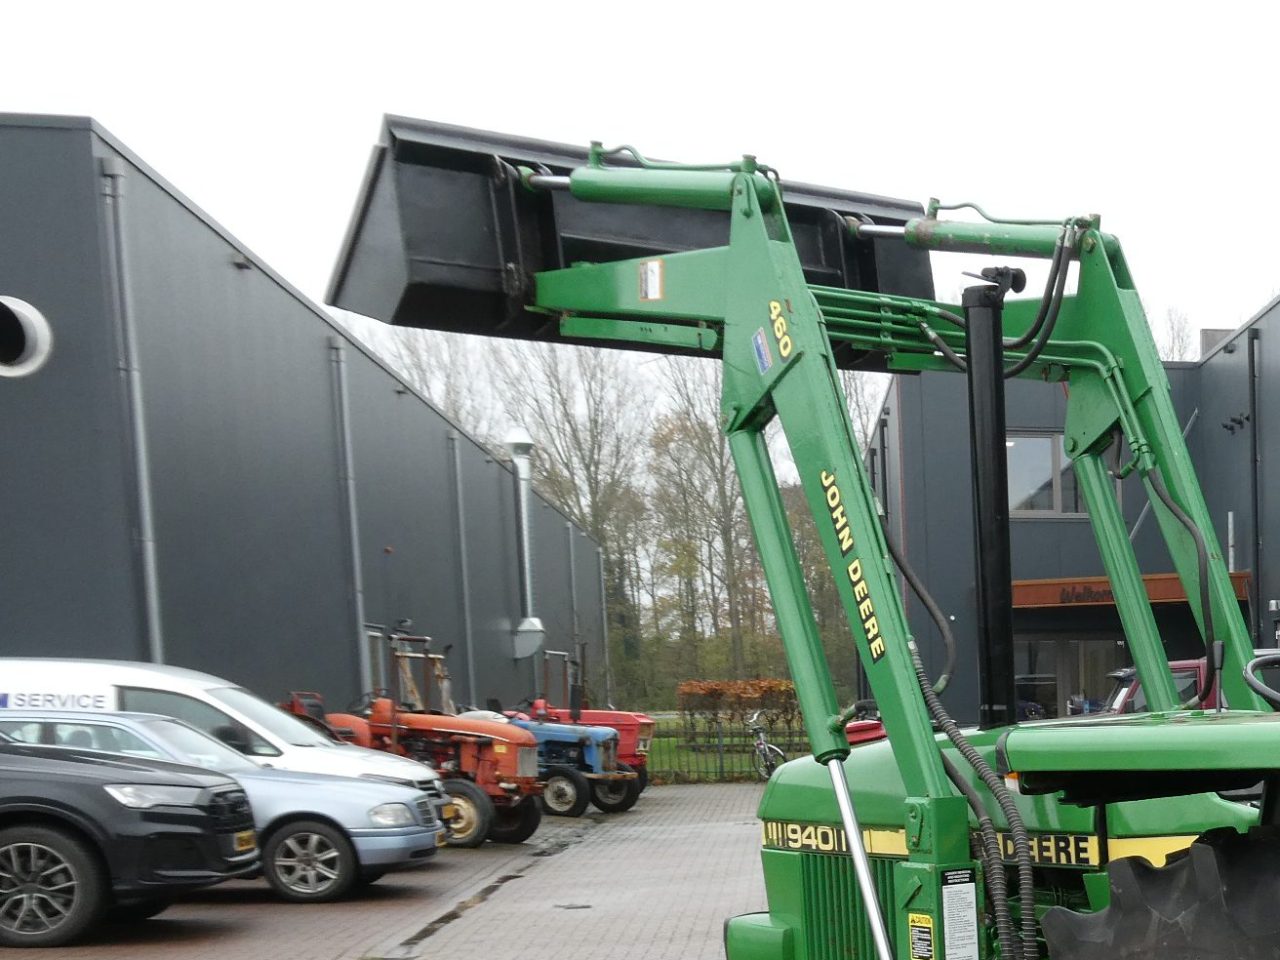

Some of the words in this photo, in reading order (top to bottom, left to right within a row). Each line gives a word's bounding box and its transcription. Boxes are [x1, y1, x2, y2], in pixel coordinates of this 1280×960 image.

[769, 300, 792, 358] 460
[820, 470, 855, 555] JOHN
[847, 557, 886, 662] DEERE
[14, 693, 105, 709] SERVICE
[787, 823, 834, 851] 940
